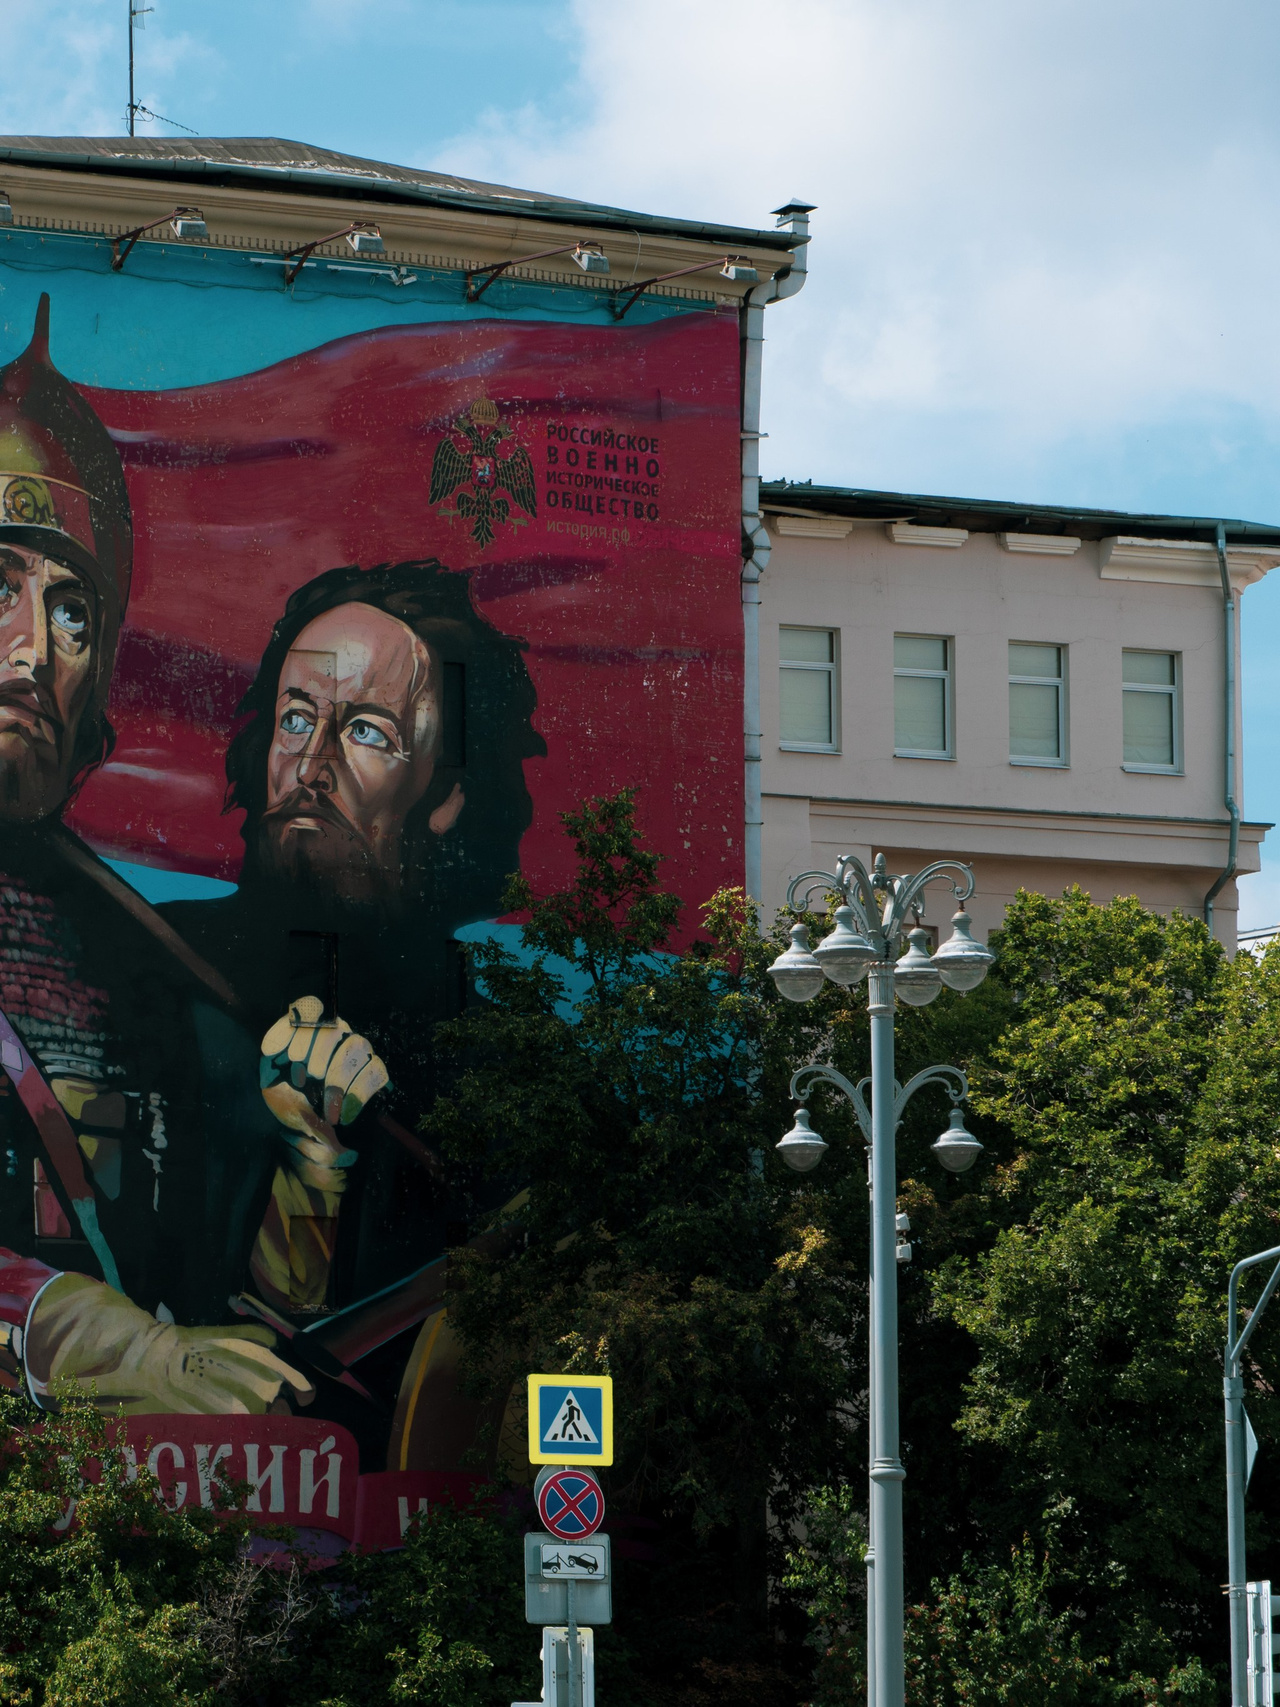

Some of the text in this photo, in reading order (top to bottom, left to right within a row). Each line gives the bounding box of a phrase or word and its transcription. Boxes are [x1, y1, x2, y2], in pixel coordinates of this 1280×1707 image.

[547, 424, 659, 454] РОССИЙСКОЕ
[547, 445, 659, 478] ВОЕННО
[546, 470, 659, 497] ИСТОРИЧЕСКОЕ
[546, 490, 659, 521] ОБЩЕСТВО
